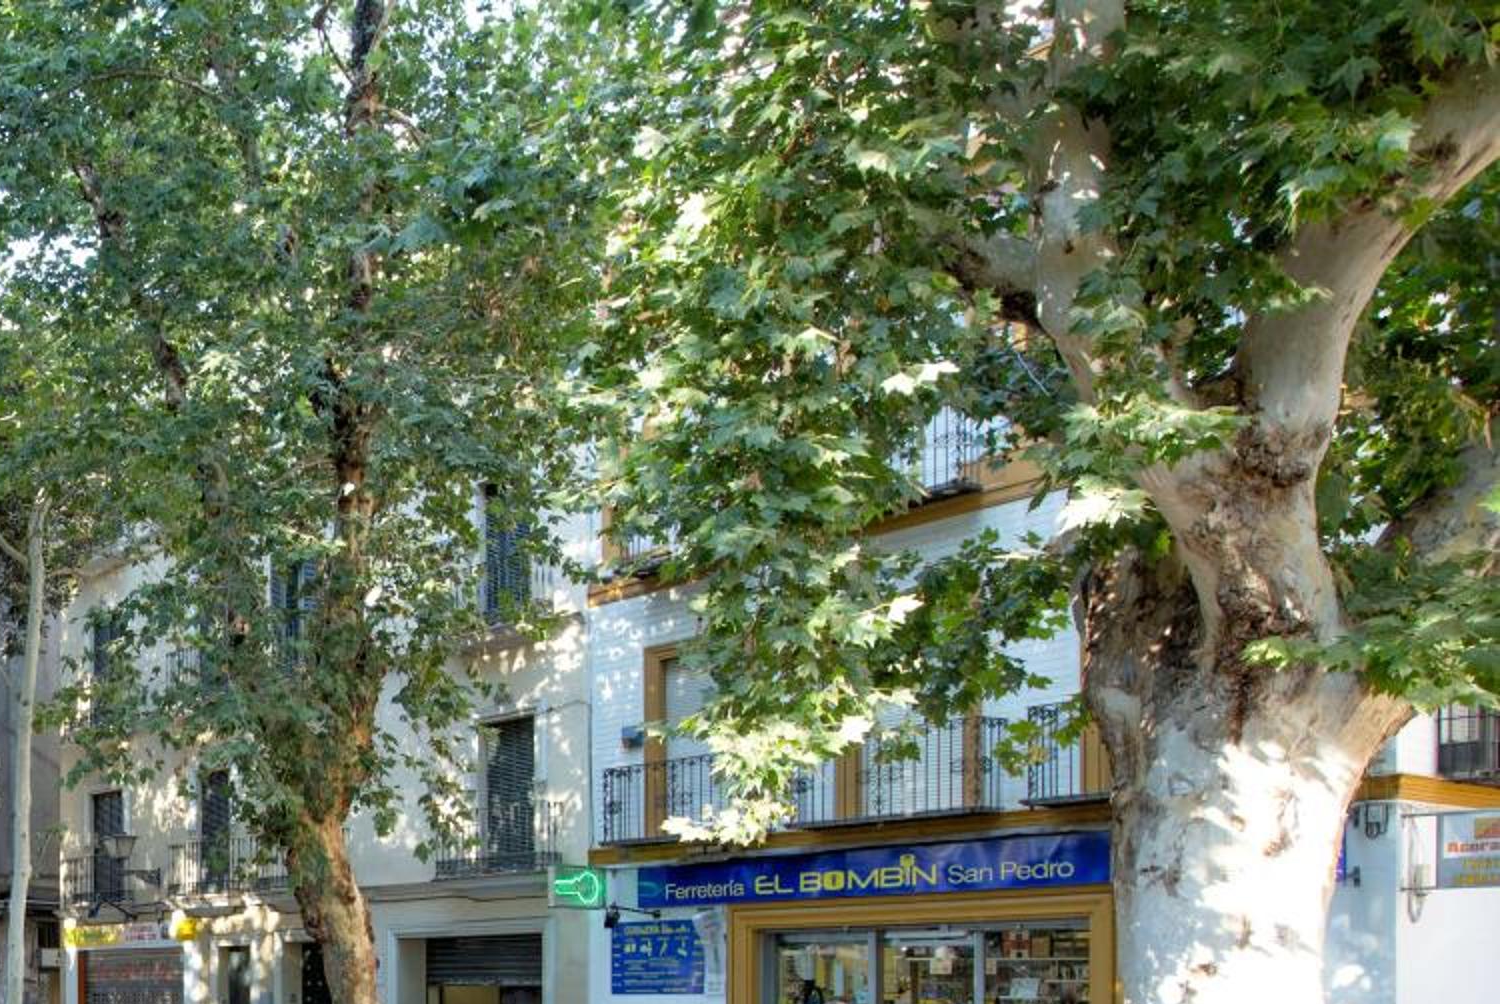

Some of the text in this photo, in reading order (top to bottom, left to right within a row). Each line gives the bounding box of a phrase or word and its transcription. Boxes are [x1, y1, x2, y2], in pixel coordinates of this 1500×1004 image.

[664, 879, 745, 900] Ferretería
[754, 875, 793, 895] EL
[947, 864, 994, 885] San
[1000, 860, 1075, 880] Pedro
